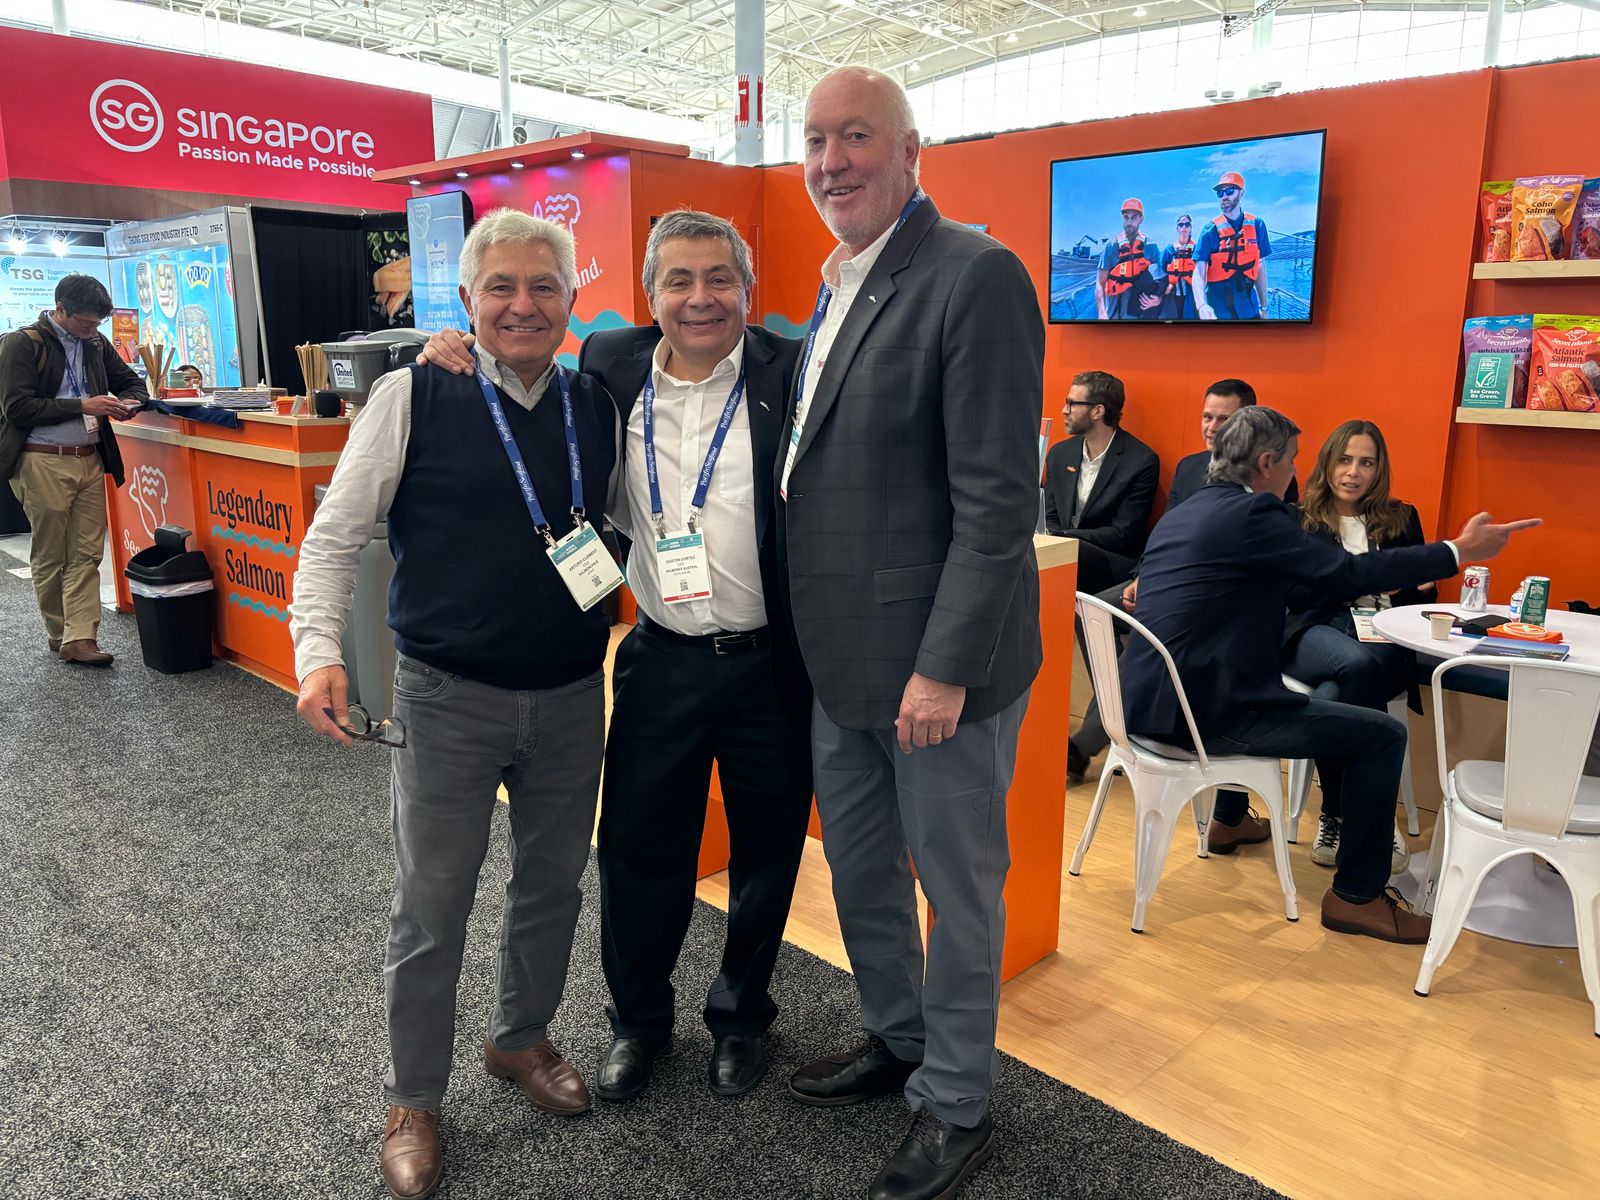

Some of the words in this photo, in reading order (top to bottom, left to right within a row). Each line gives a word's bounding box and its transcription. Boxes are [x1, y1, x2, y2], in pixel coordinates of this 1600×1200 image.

[101, 98, 155, 133] SG
[178, 142, 251, 164] Passion
[255, 150, 304, 170] Made
[308, 156, 376, 178] Possible
[1525, 207, 1556, 215] Salmon
[149, 231, 161, 242] FOOD
[181, 227, 190, 238] PTE
[190, 226, 199, 237] LTD
[10, 268, 45, 281] TSG
[575, 255, 603, 288] and.
[1551, 355, 1583, 363] Salmon
[1552, 347, 1585, 356] Atlantic
[207, 481, 293, 543] Legendary
[225, 548, 287, 600] Salmon
